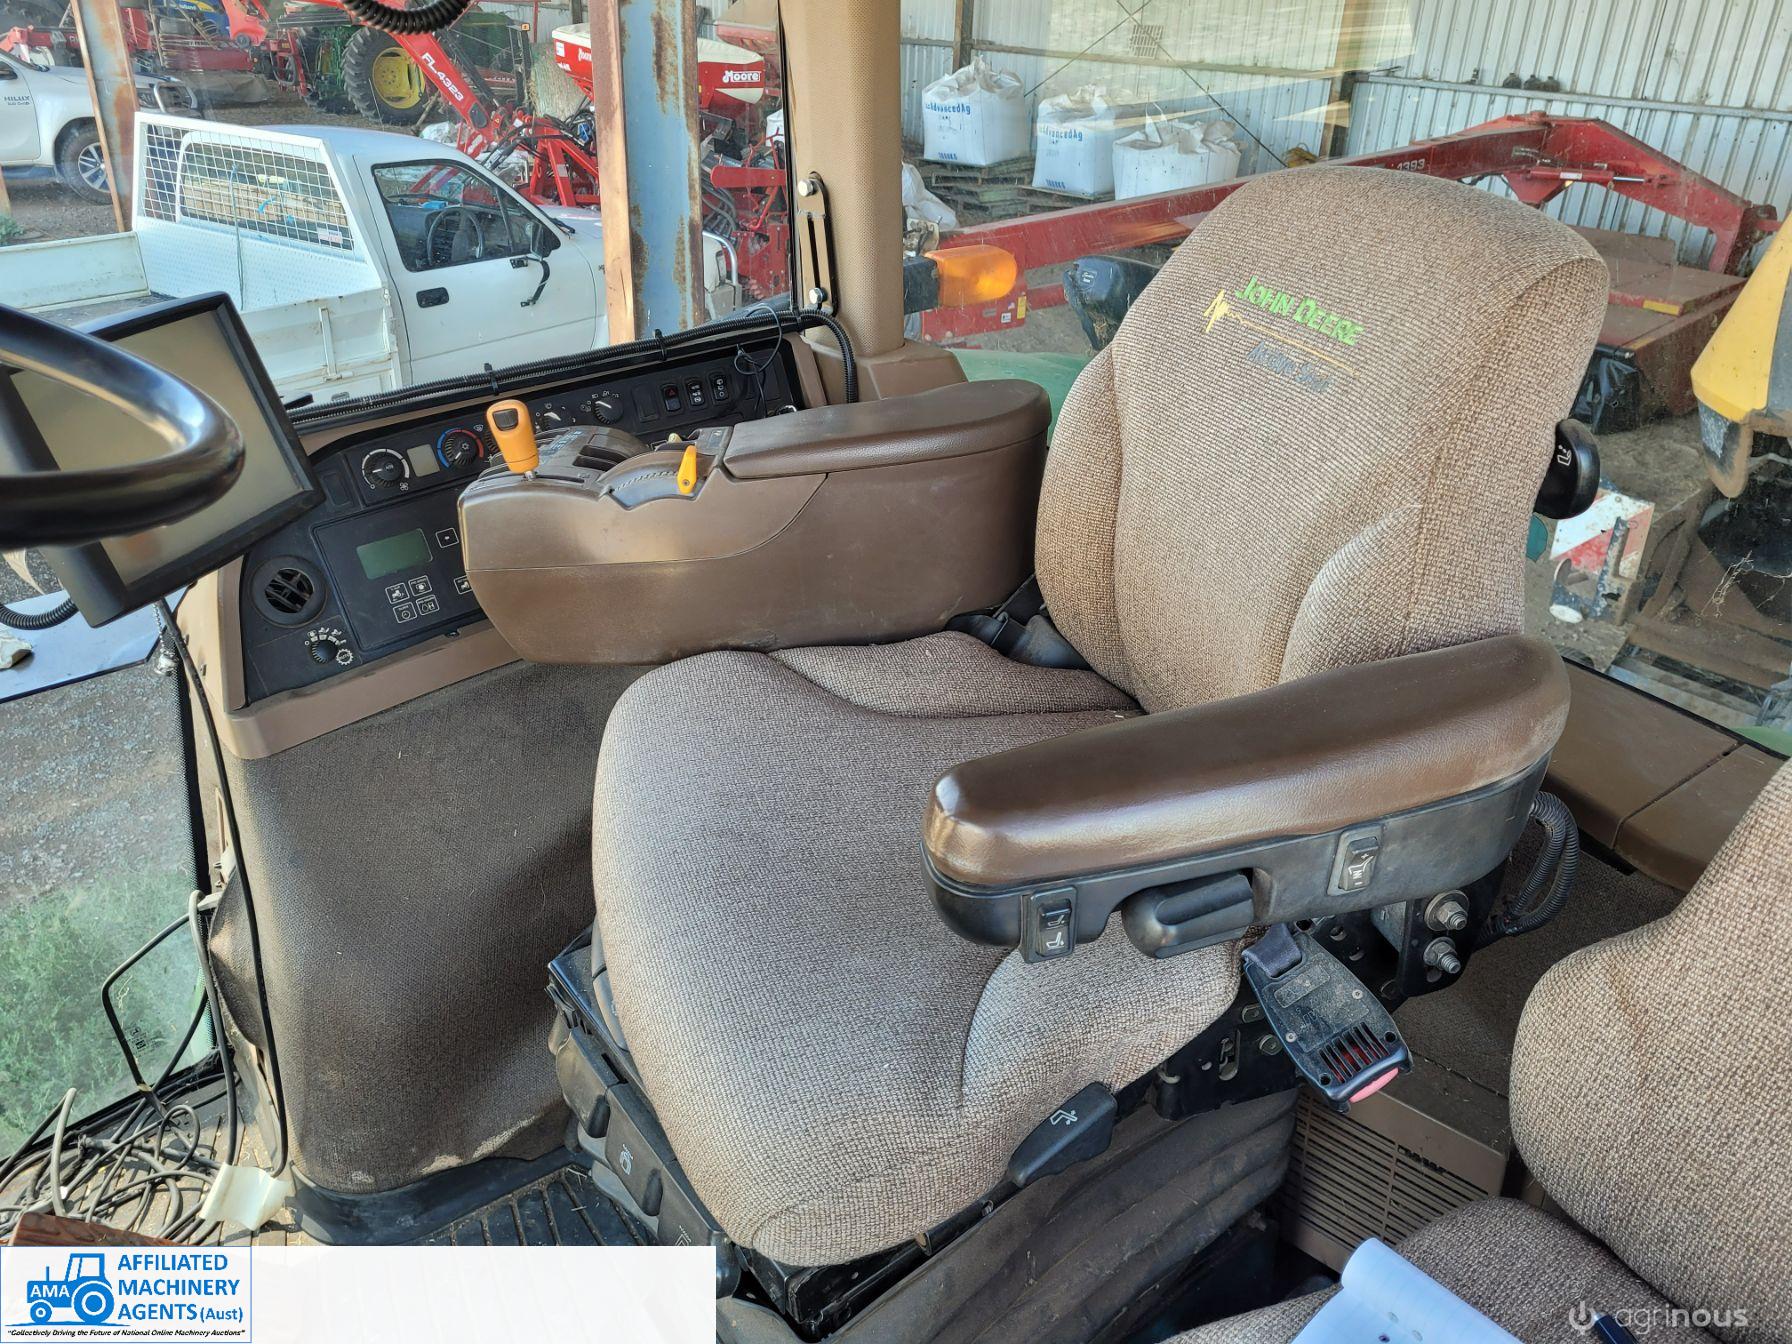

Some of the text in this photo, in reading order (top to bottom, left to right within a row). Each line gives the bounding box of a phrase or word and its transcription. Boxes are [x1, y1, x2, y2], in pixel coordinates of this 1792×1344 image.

[722, 69, 762, 83] Moore
[1234, 275, 1365, 346] JOHN DEERE
